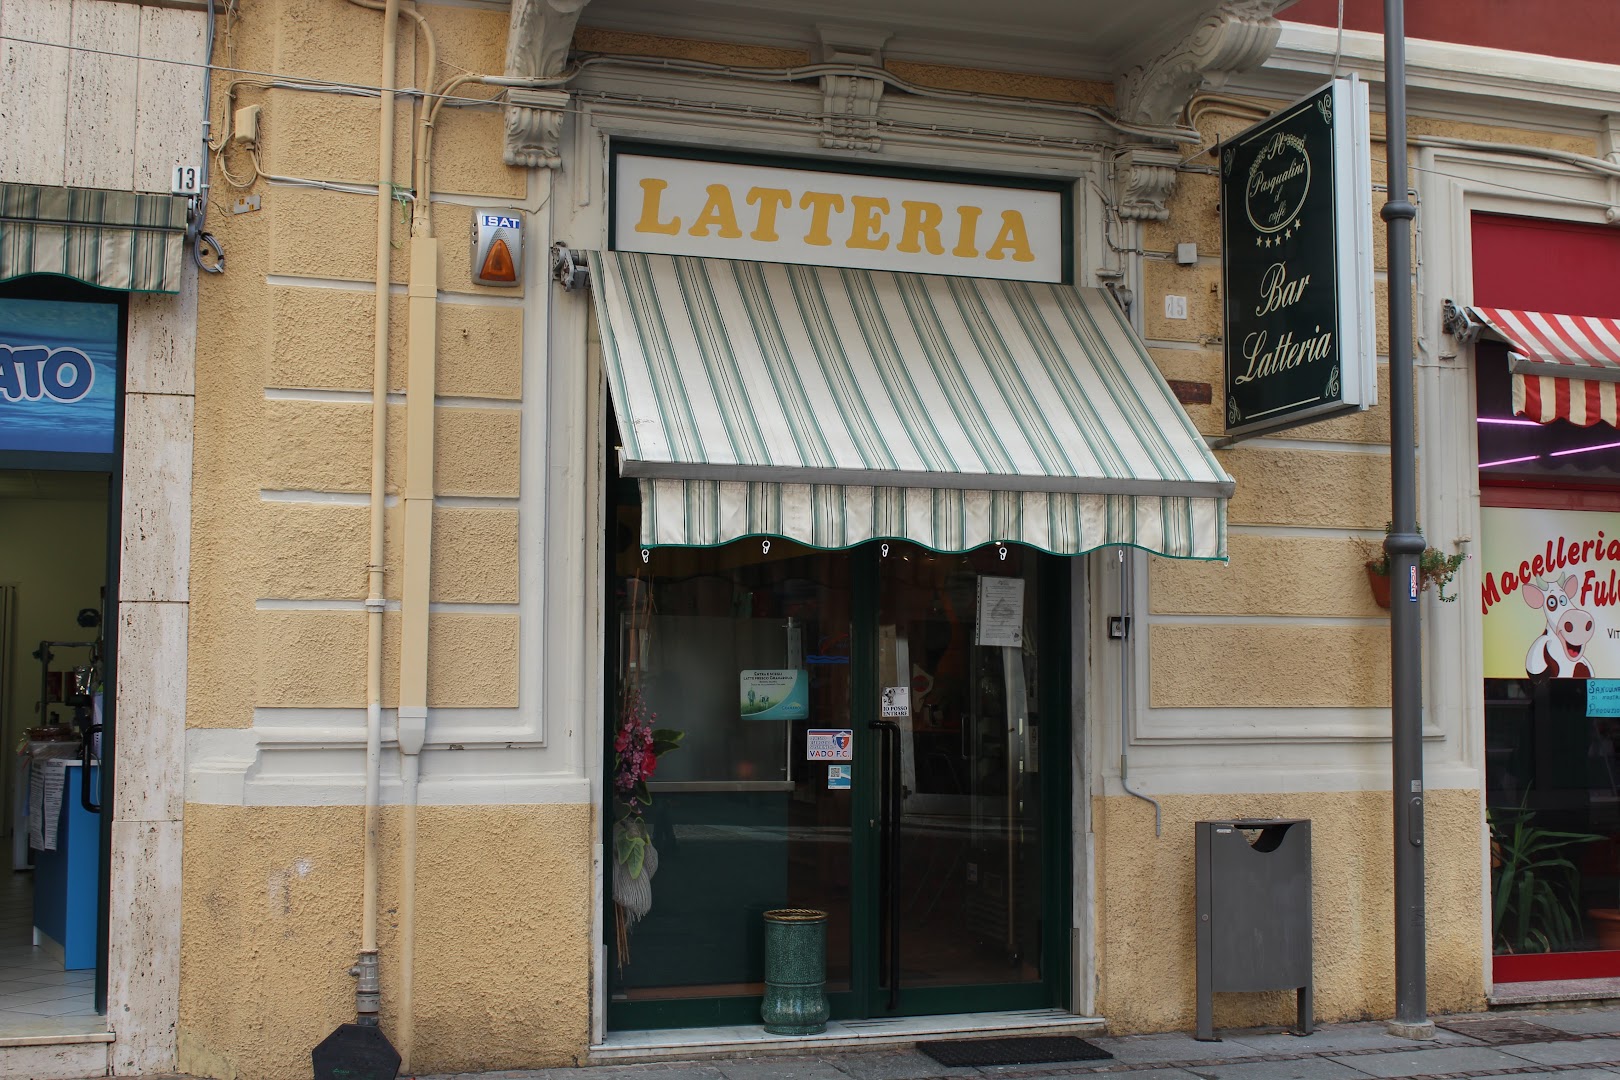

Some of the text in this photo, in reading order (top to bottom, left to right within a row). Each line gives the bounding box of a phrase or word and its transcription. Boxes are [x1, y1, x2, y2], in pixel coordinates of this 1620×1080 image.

[178, 167, 195, 189] 13
[1249, 157, 1306, 198] Pasqualini
[482, 215, 520, 234] ISAT
[634, 177, 1035, 263] LATTERIA
[1255, 260, 1311, 317] Bar
[1234, 324, 1332, 385] Latteria
[1481, 530, 1620, 615] Macelleria
[1580, 568, 1620, 607] Ful
[809, 750, 834, 758] VADO
